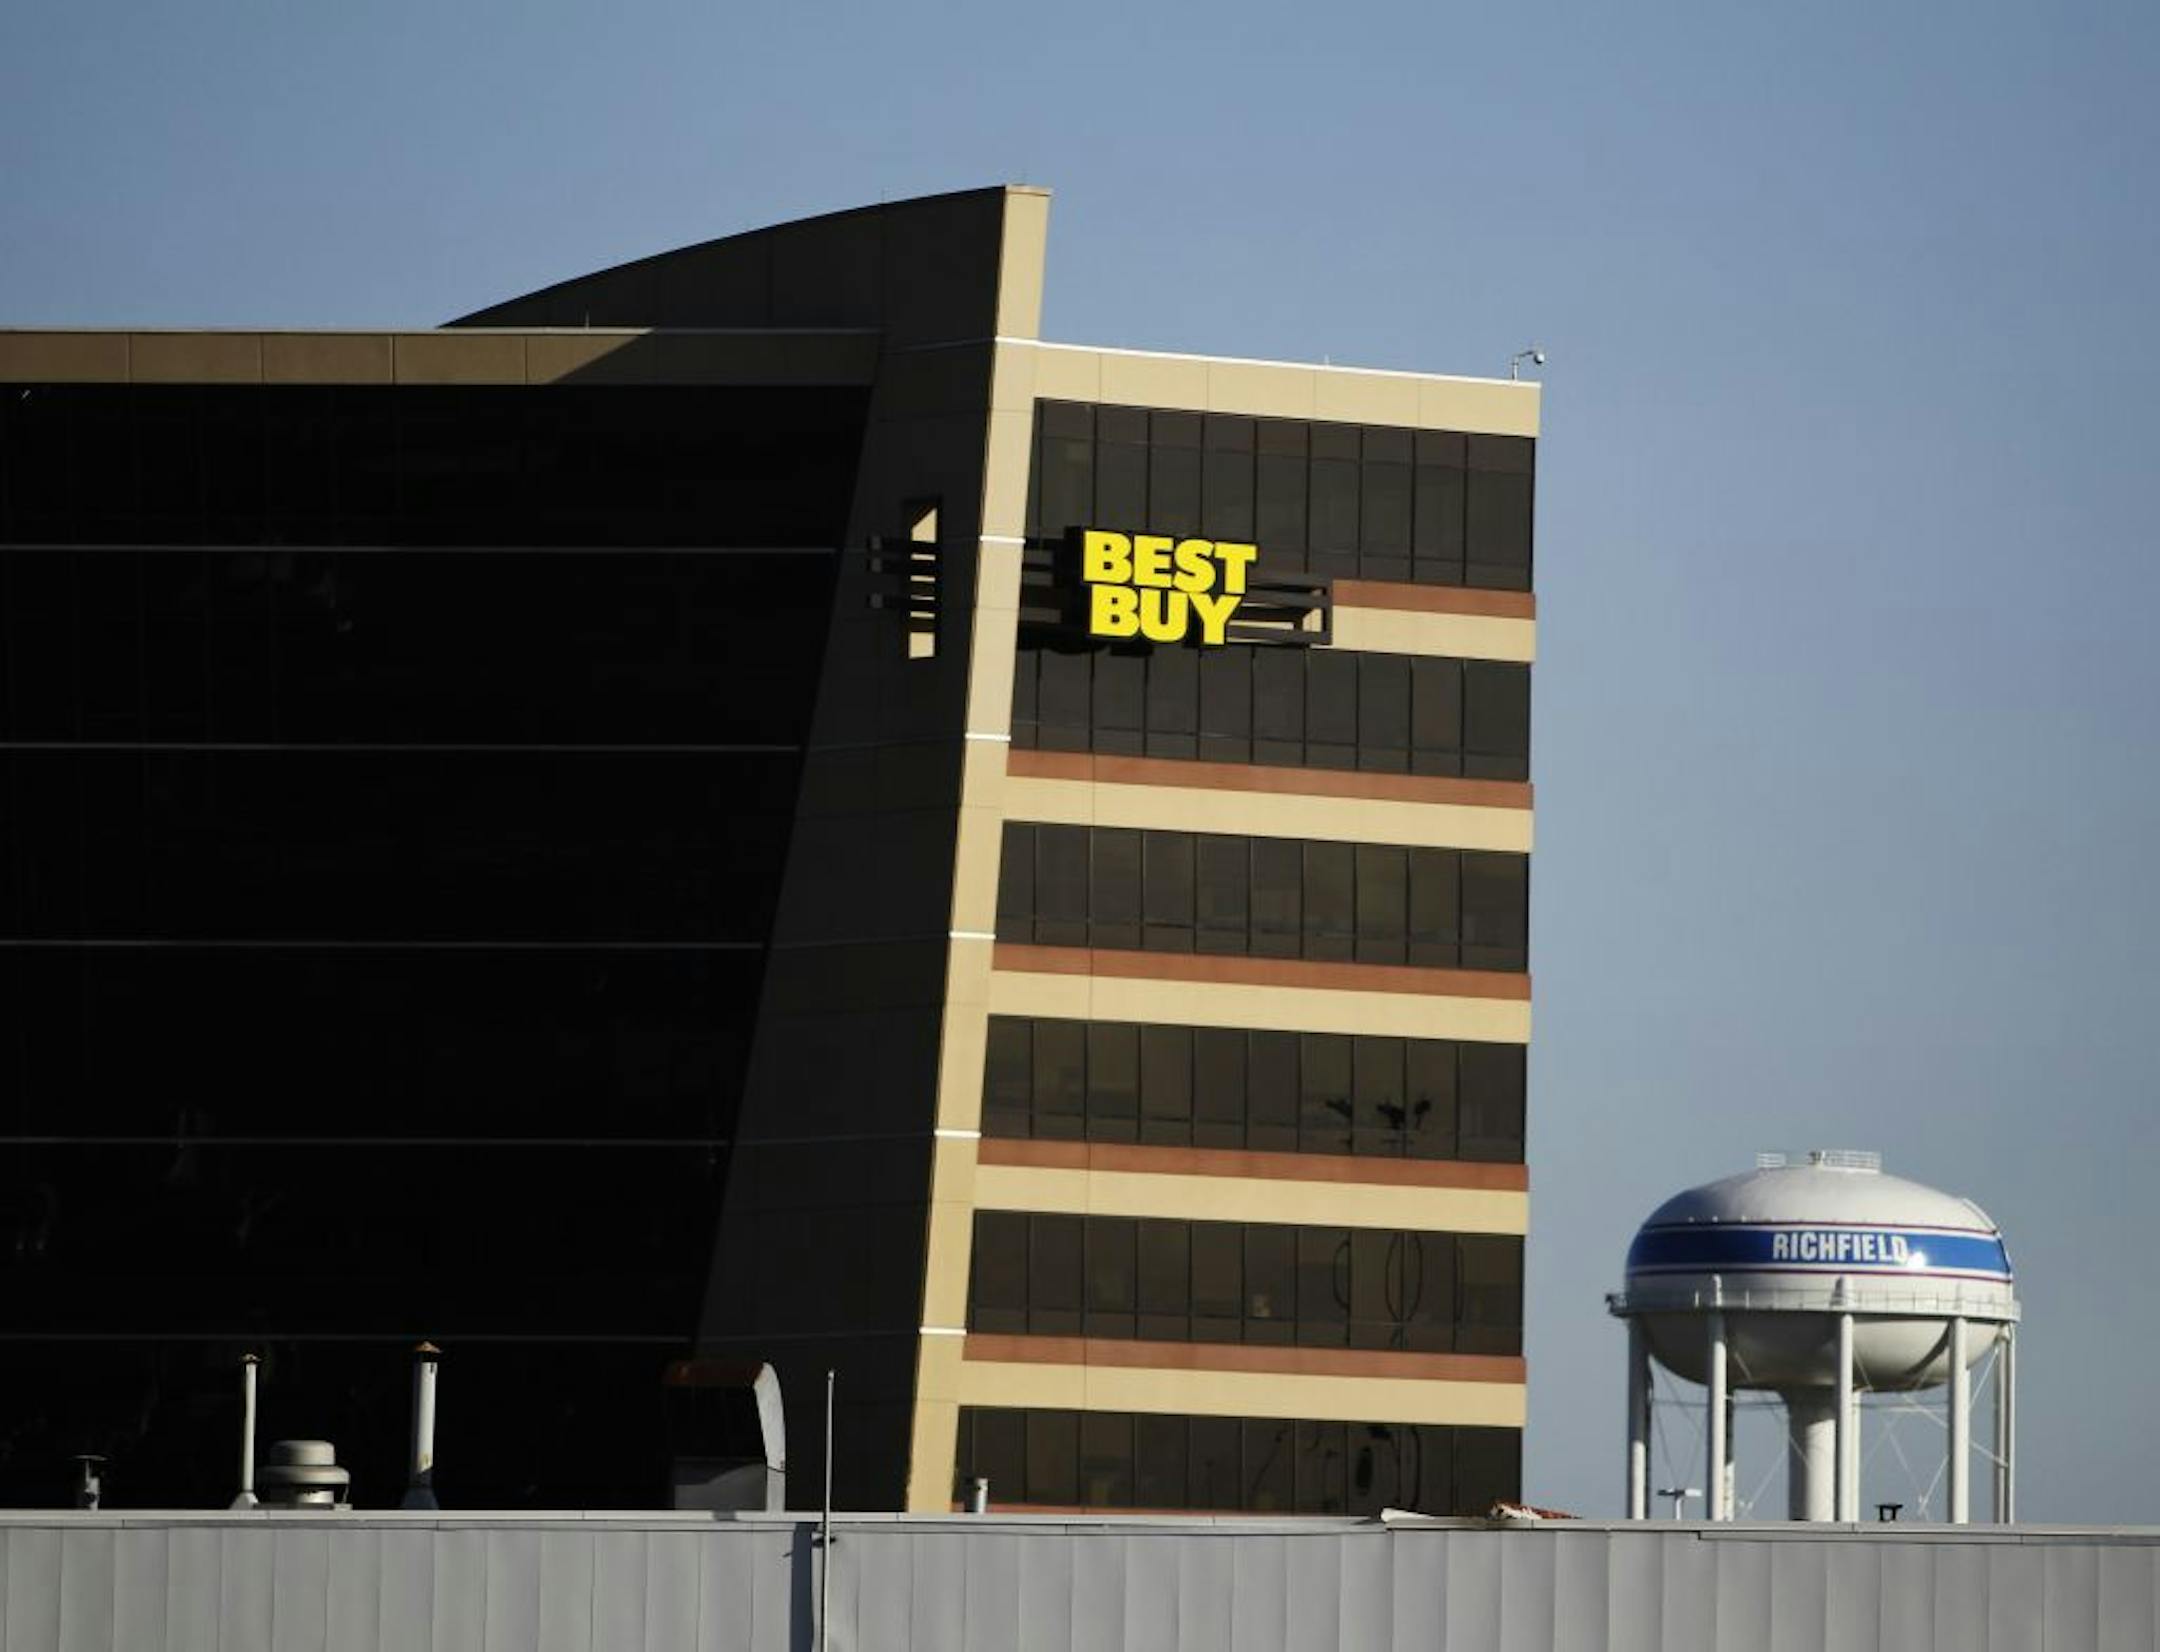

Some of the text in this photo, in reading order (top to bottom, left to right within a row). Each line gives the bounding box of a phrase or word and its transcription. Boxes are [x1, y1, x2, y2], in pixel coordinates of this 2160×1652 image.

[1083, 531, 1257, 594] BEST
[1090, 584, 1242, 645] BUY
[1772, 1232, 1908, 1264] RICHFIELD
